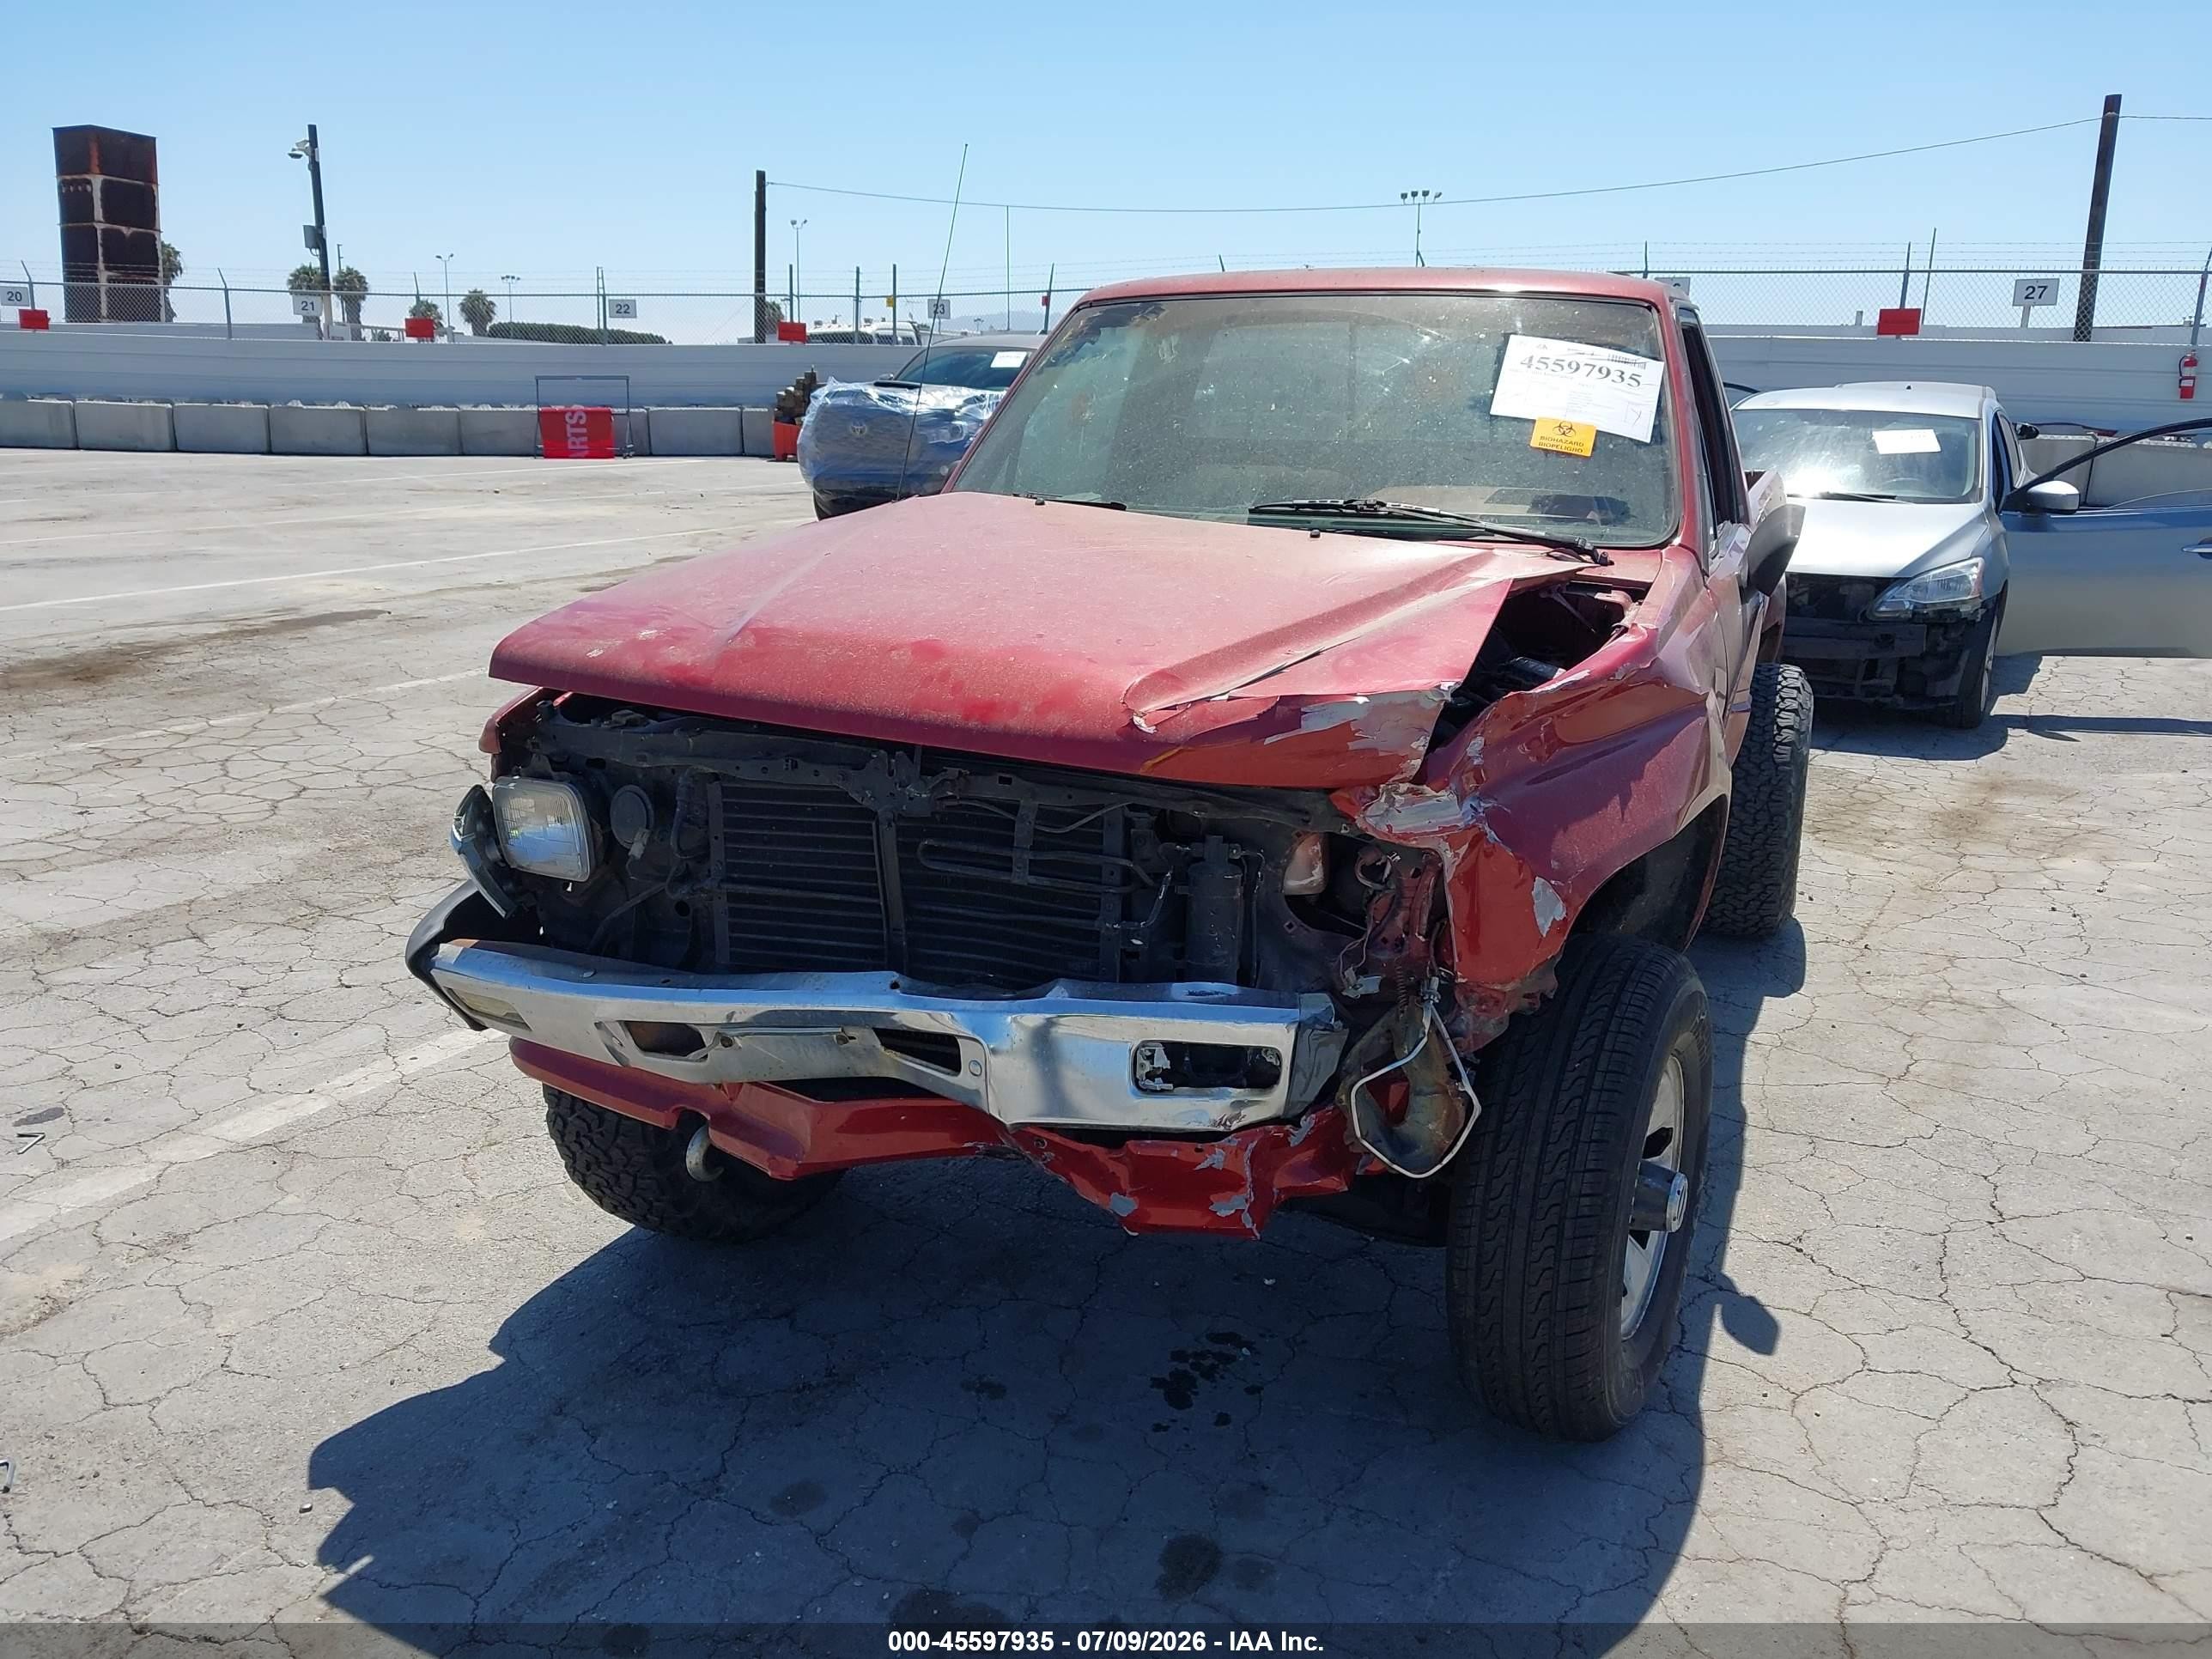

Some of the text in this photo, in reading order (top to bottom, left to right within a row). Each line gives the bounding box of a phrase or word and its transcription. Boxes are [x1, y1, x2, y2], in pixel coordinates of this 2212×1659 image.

[7, 290, 22, 301] 20
[2024, 285, 2048, 300] 27
[301, 301, 314, 311] 21
[615, 303, 630, 314] 22
[933, 303, 945, 314] 23
[1520, 355, 1643, 388] 45597935
[1539, 435, 1585, 447] BIOHAZARD
[1538, 441, 1583, 453] BIOPELIGRO
